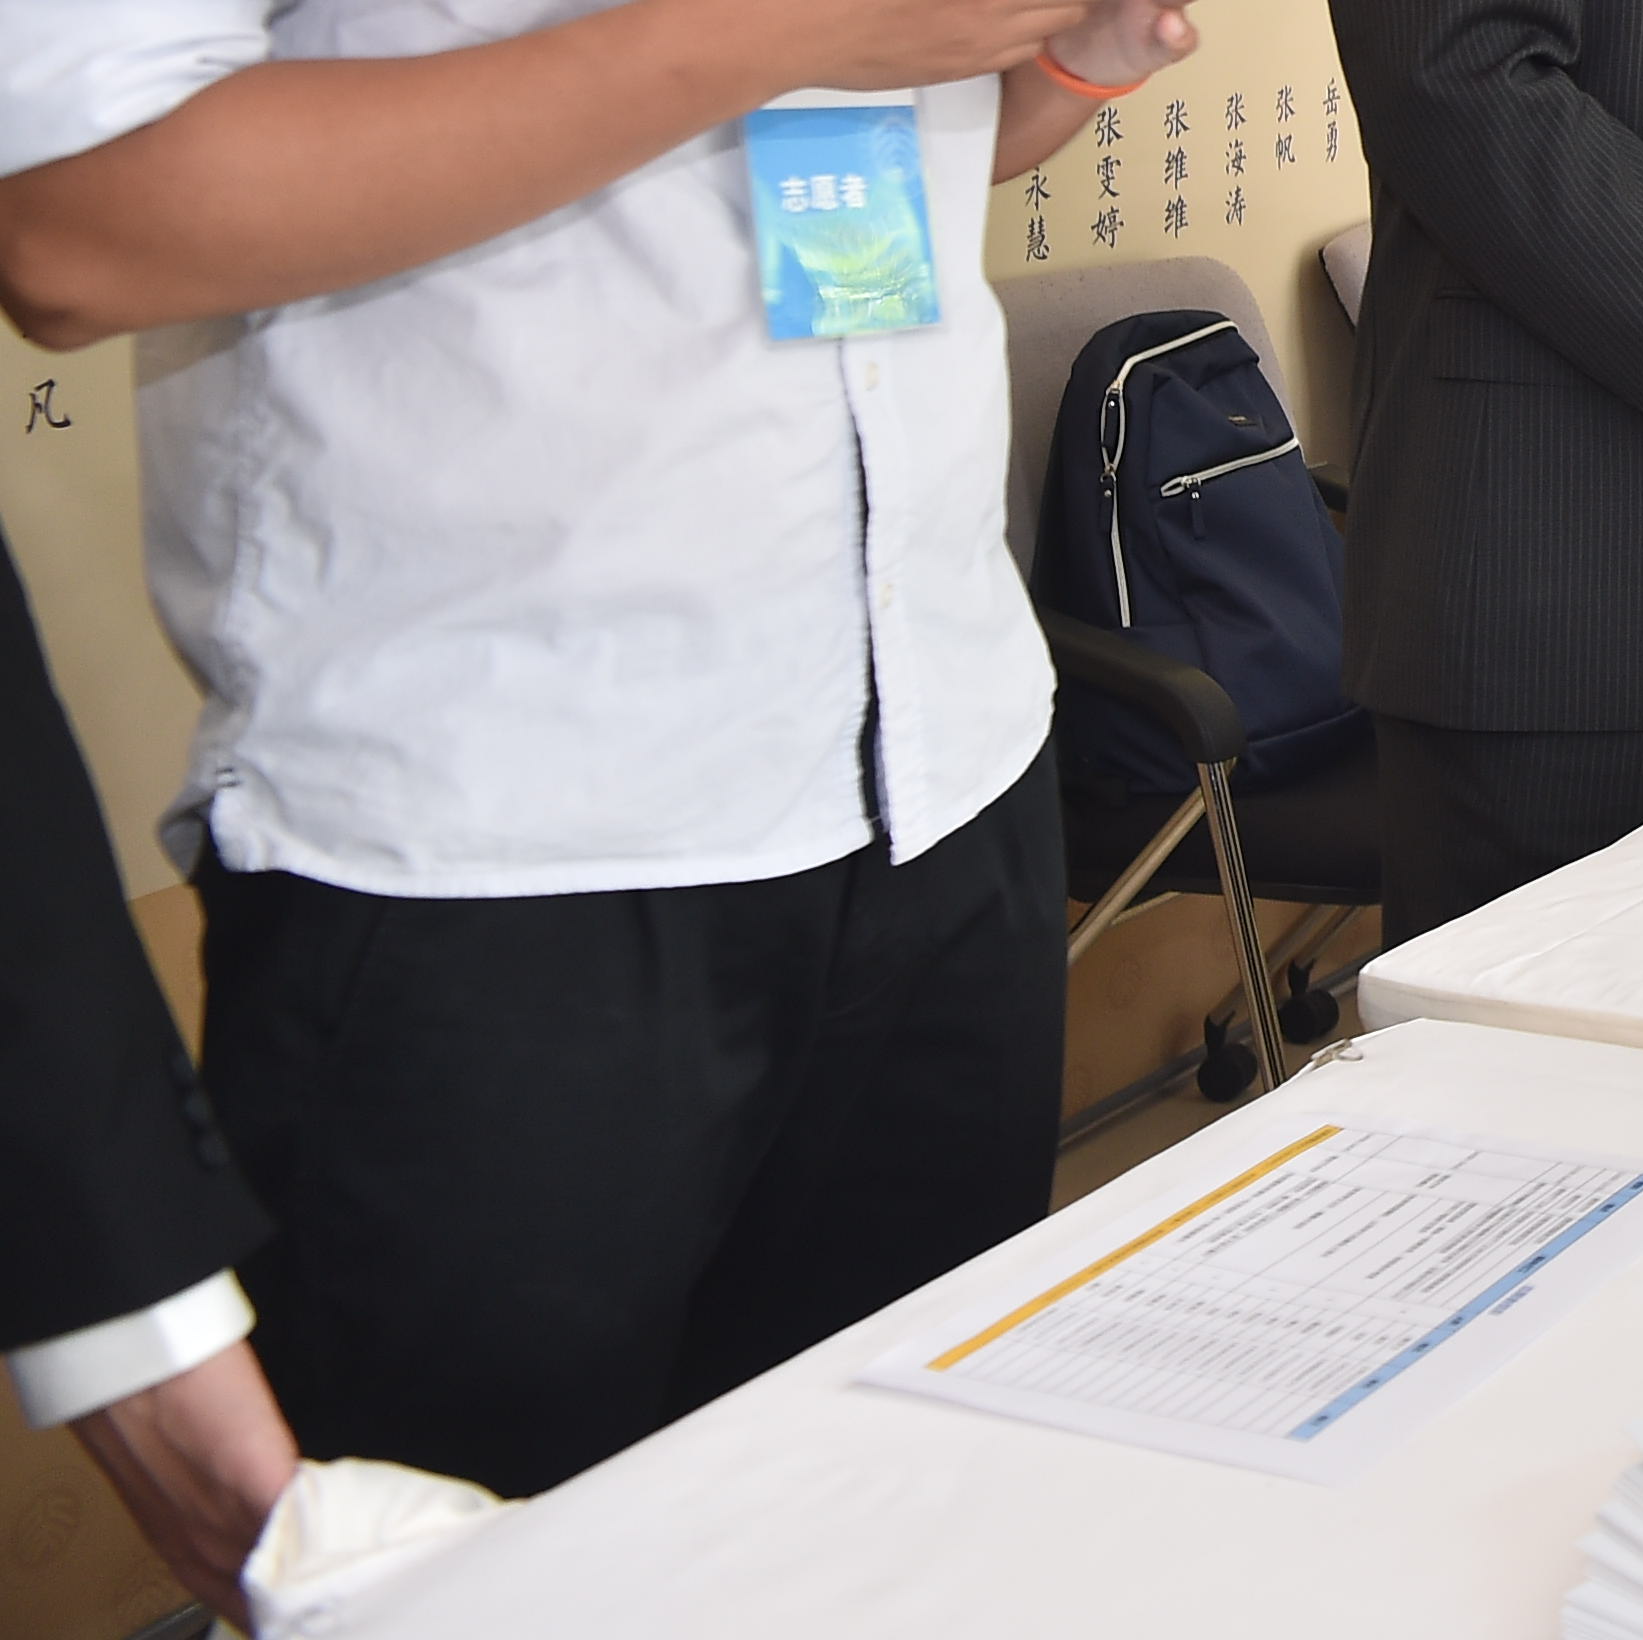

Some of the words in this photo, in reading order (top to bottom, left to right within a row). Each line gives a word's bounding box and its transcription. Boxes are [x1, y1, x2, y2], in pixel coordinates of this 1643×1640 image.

[1090, 106, 1125, 249] 张雯婷
[1163, 99, 1190, 239] 张维维
[1225, 92, 1247, 226] 张海涛
[1275, 85, 1296, 171] 张帆
[1322, 77, 1341, 163] 岳勇
